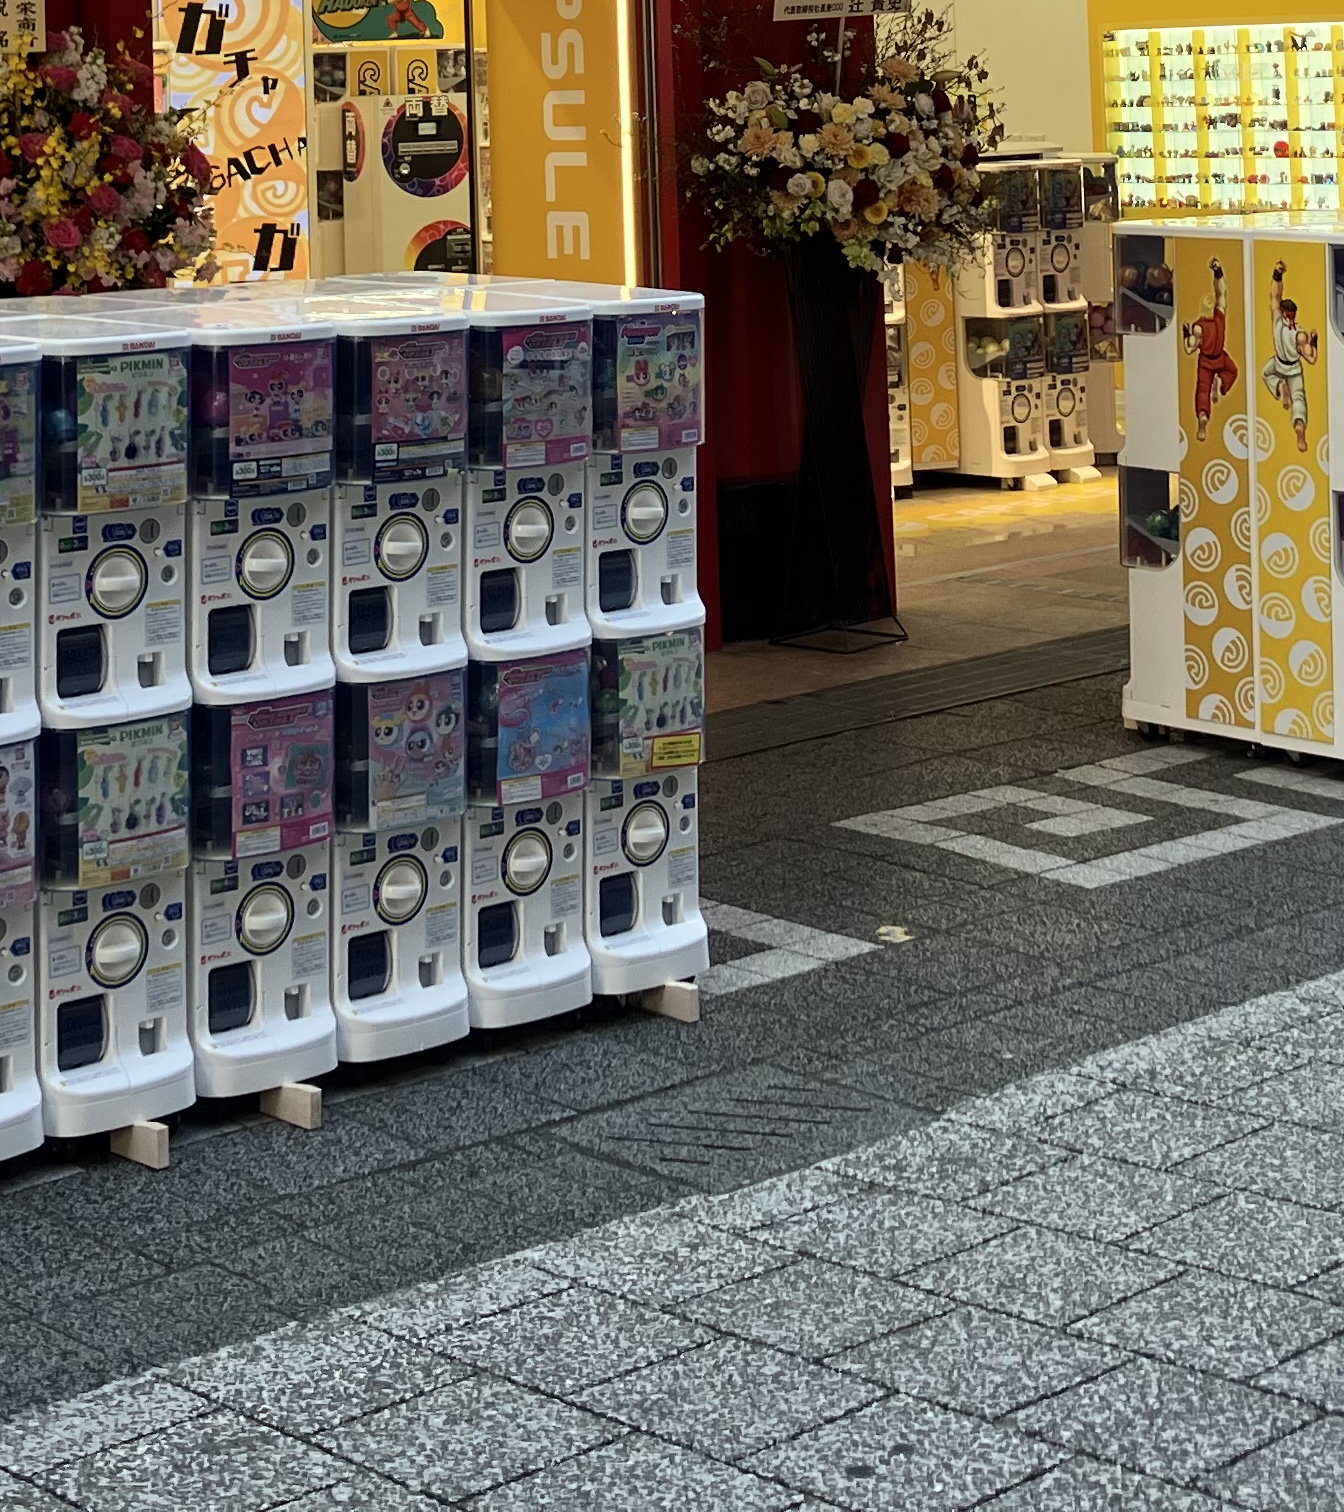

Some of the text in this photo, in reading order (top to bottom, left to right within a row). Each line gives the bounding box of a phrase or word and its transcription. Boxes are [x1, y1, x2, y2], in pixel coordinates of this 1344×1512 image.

[405, 95, 449, 117] 両替
[129, 340, 156, 351] BANDAI
[120, 357, 164, 372] PIKMIN
[651, 637, 686, 652] PIKMIN
[119, 724, 164, 742] PIKMIN
